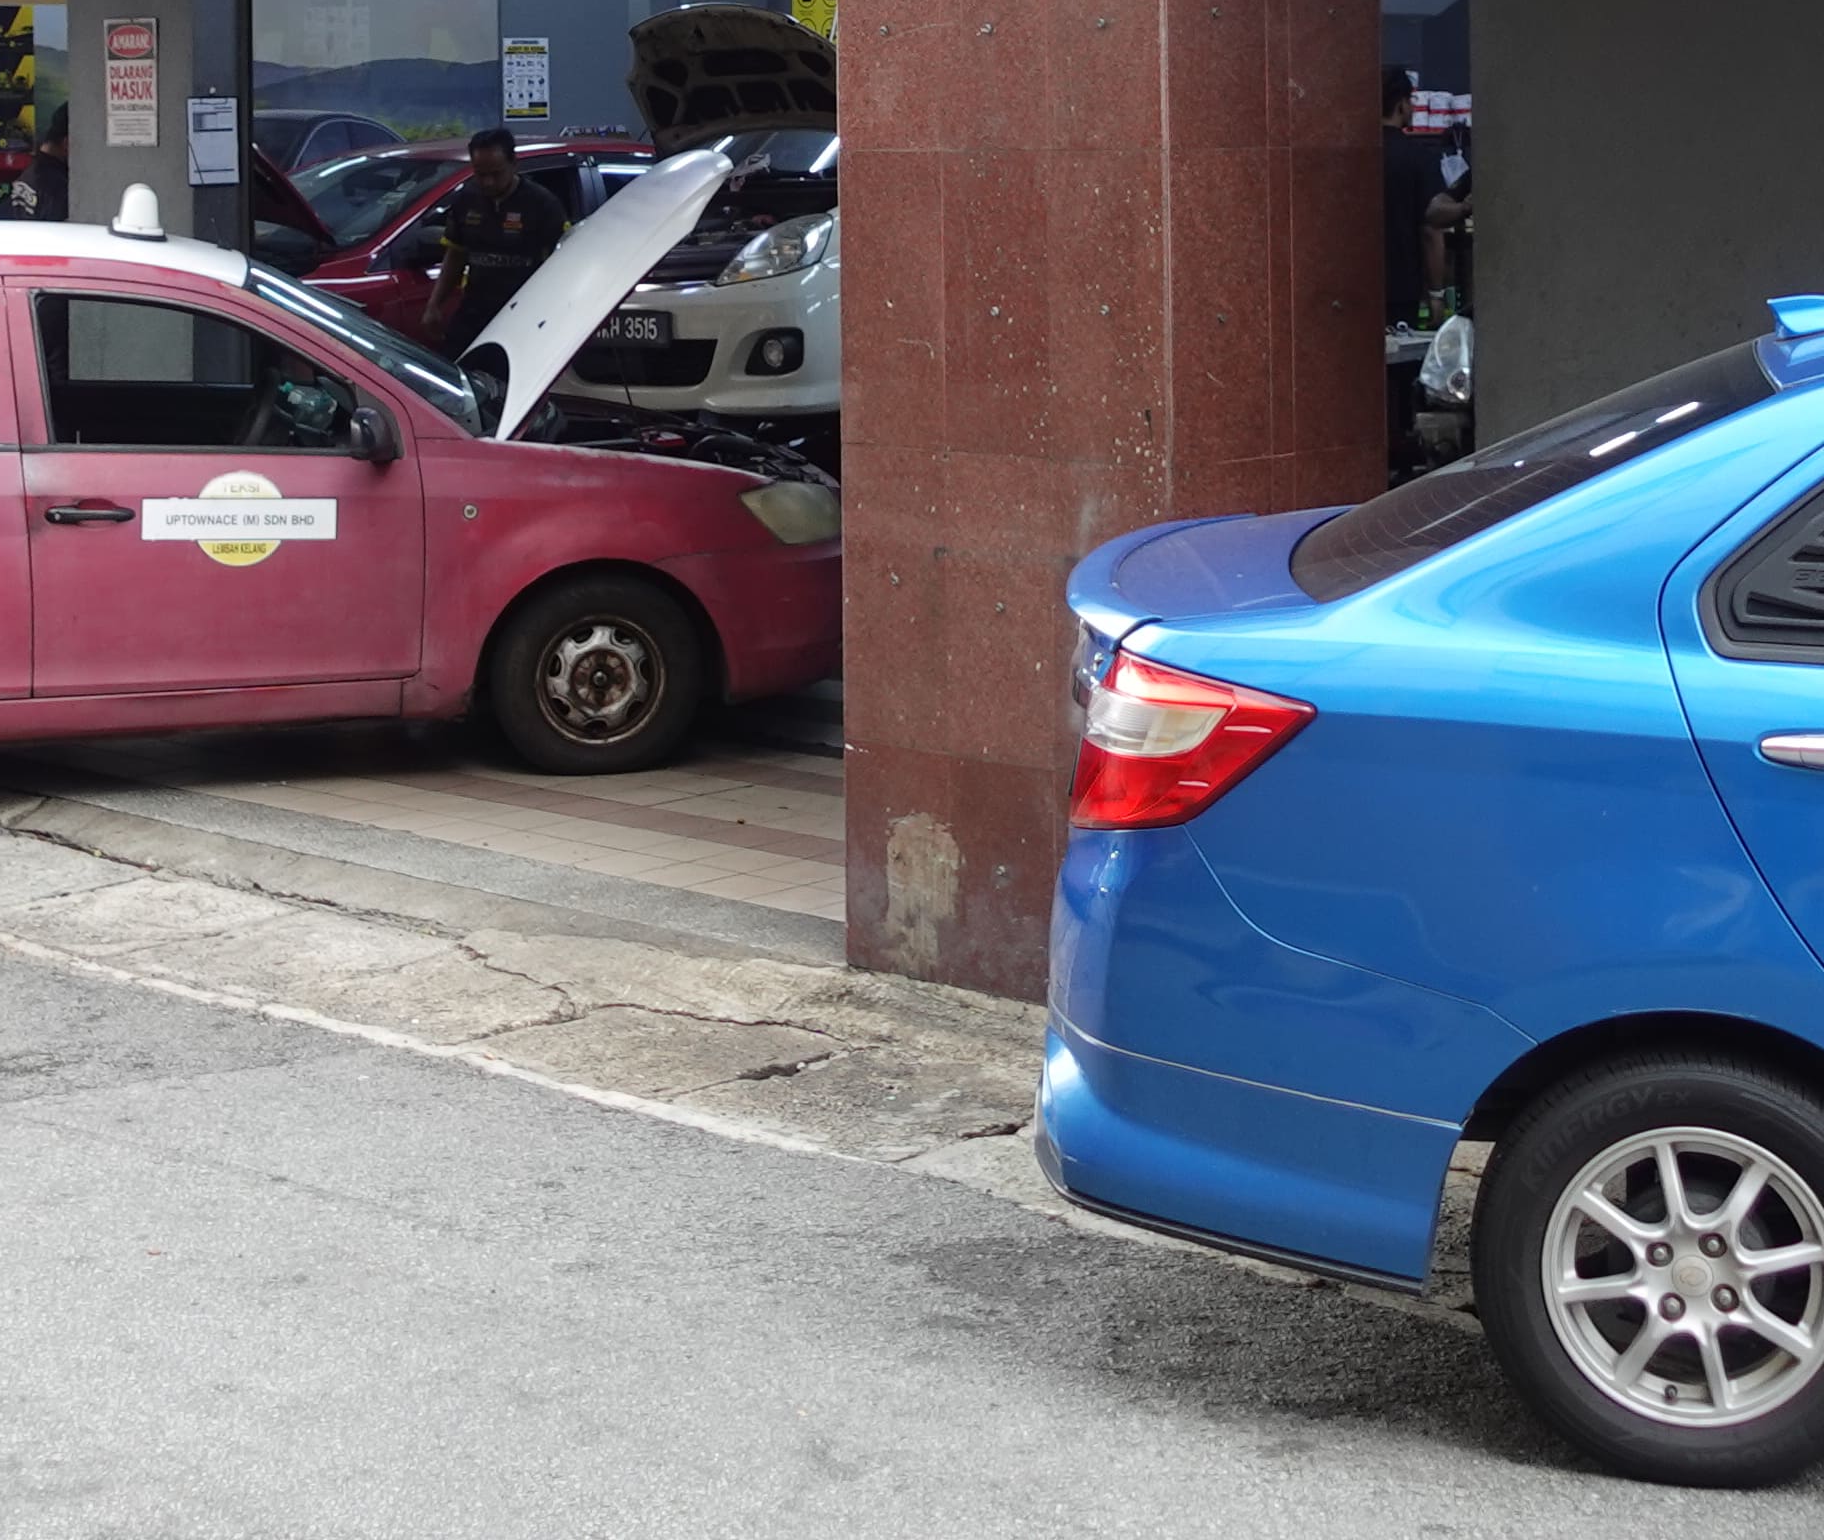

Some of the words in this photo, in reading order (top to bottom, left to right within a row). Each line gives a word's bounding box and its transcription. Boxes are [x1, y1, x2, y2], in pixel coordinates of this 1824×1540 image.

[110, 65, 153, 79] DILARANG
[111, 80, 153, 101] MASUK
[624, 316, 658, 340] 3515
[223, 482, 260, 494] TEKSI
[165, 514, 238, 526] UPTOWNACE
[242, 514, 260, 526] (M)
[264, 514, 287, 526] SDN
[291, 514, 315, 526] BHD
[212, 543, 239, 555] LEMBAH
[240, 543, 267, 555] KELANG
